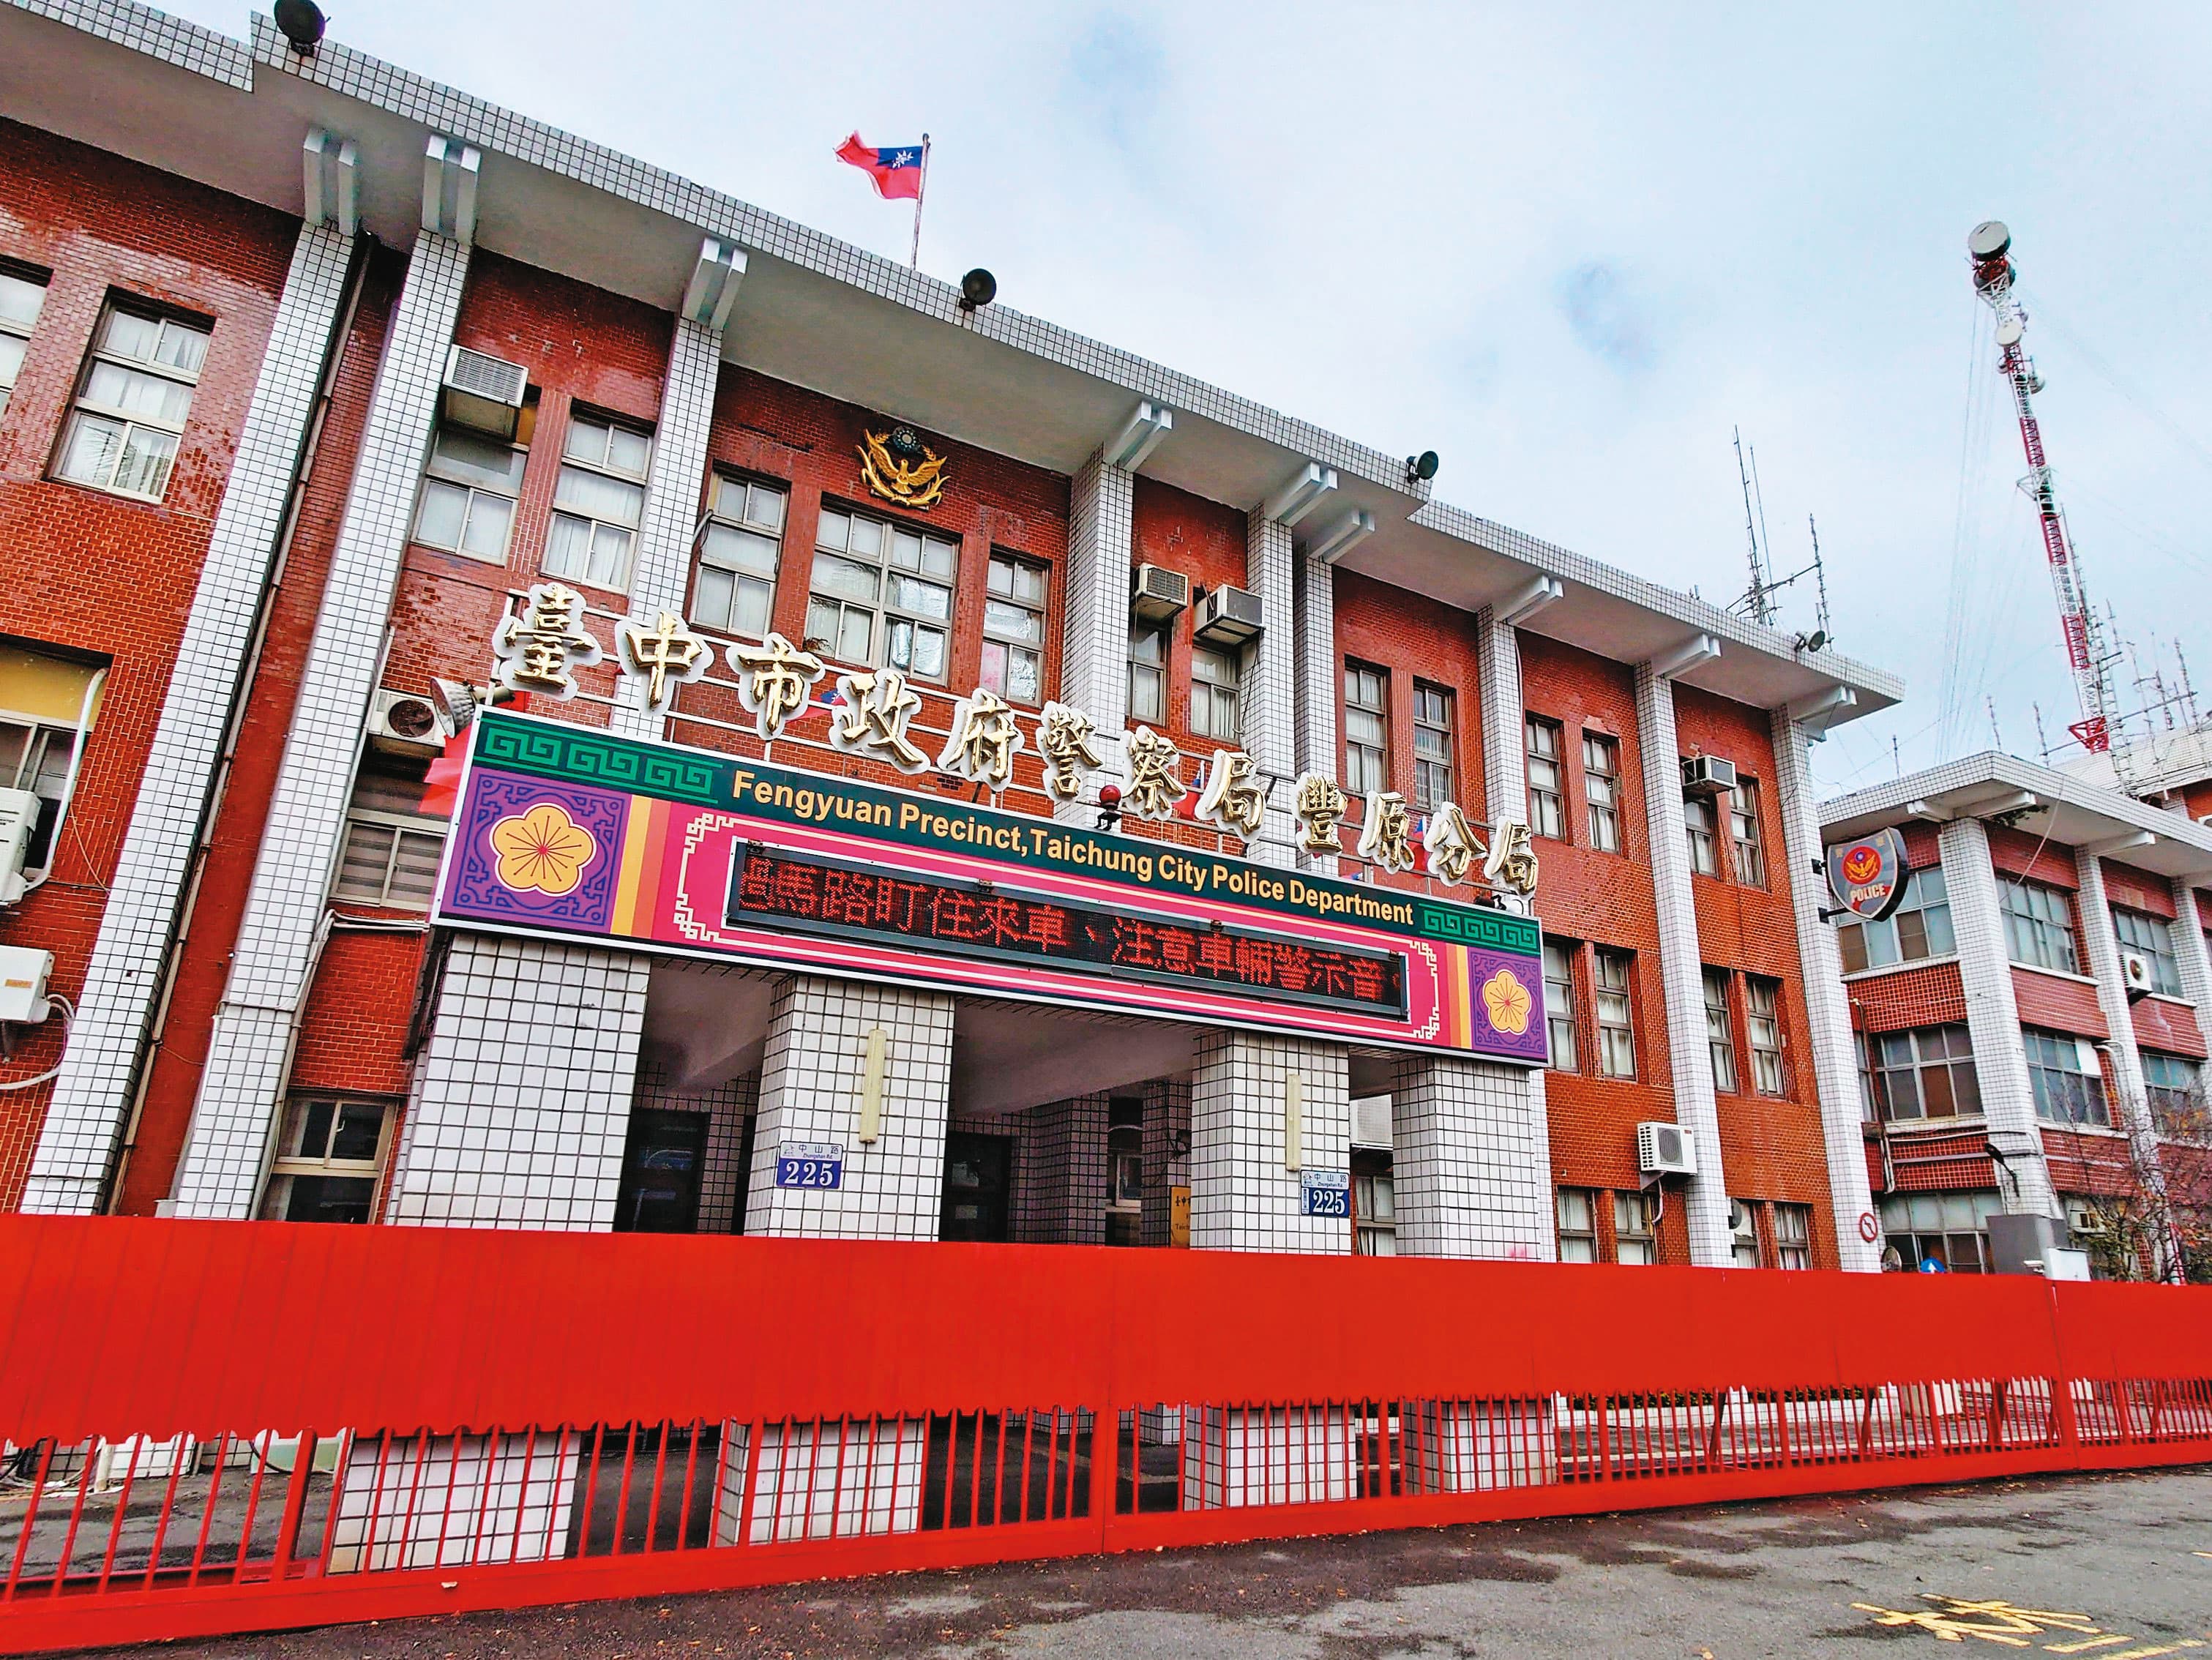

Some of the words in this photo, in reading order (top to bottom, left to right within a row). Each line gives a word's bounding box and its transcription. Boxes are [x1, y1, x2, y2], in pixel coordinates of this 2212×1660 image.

[502, 585, 1538, 896] 臺中市政府警察局豐原分局
[733, 770, 893, 828] Fengyuan
[1159, 854, 1208, 891] City
[1212, 864, 1285, 901] Police
[1290, 879, 1414, 925] Department
[1850, 883, 1886, 903] POLICE
[799, 1144, 839, 1154] 中山路
[784, 1161, 833, 1186] 225
[1314, 1173, 1347, 1183] 中山路
[1312, 1189, 1345, 1214] 225
